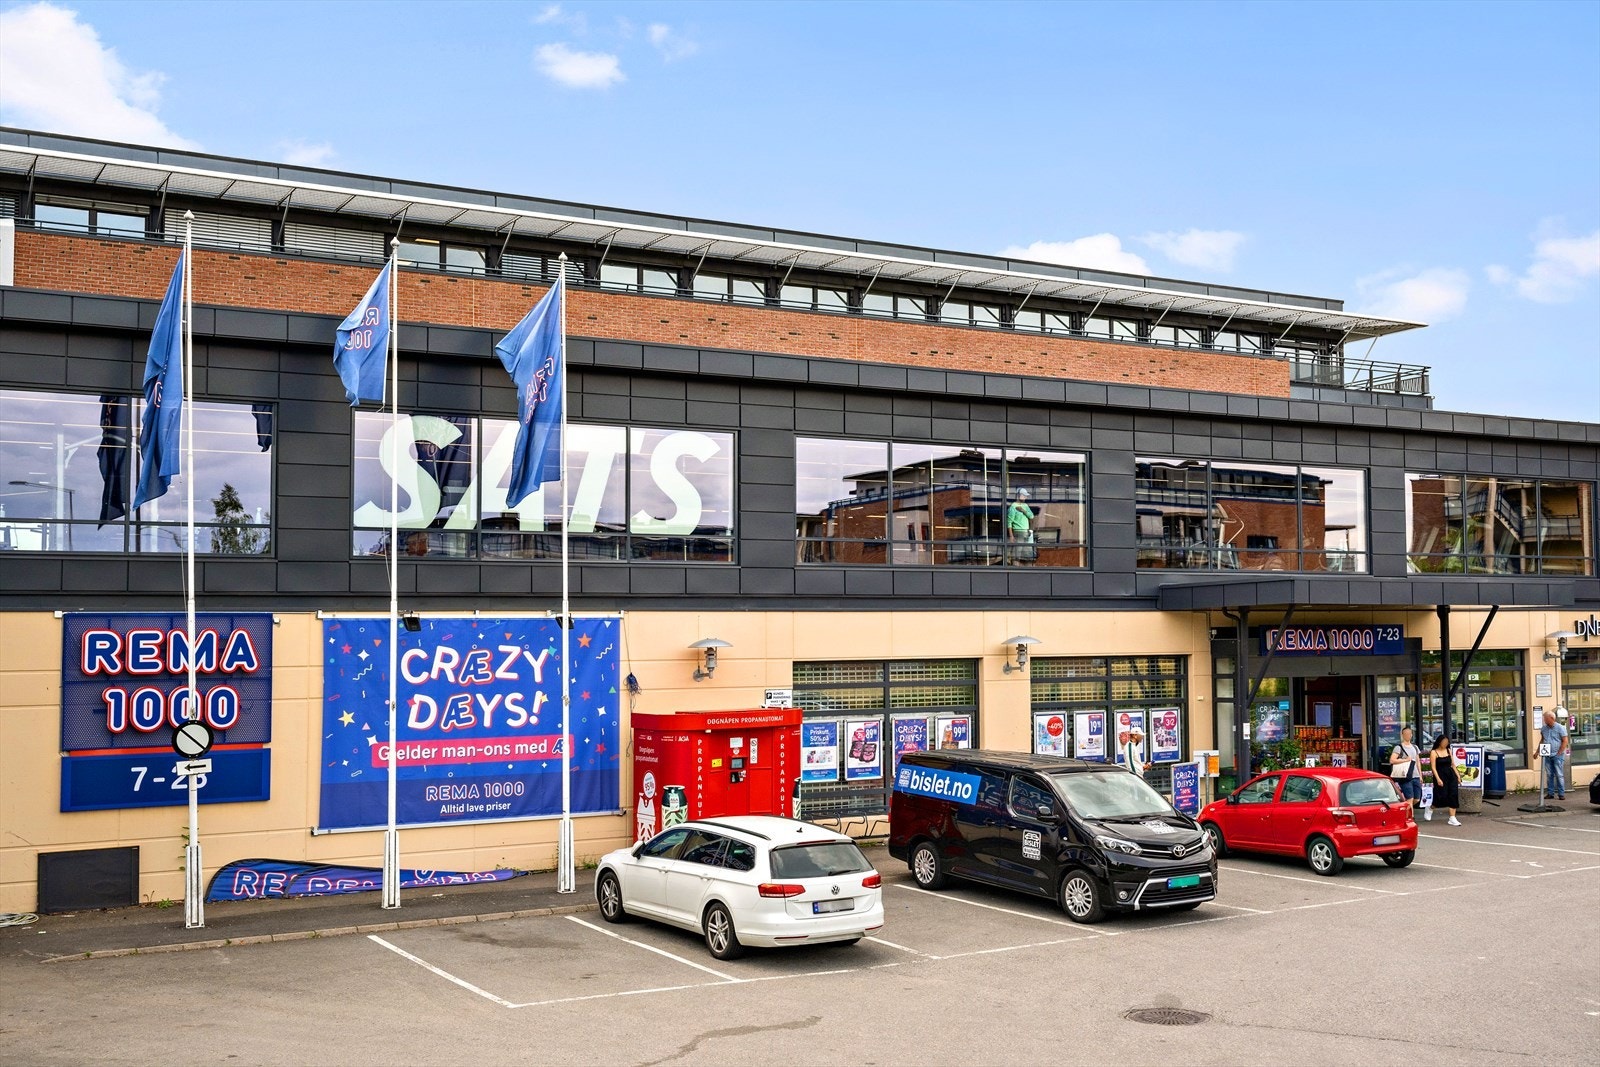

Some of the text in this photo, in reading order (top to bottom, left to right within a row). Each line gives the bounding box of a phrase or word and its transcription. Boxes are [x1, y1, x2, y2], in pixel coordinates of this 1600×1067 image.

[354, 413, 721, 536] SATS
[1329, 629, 1374, 650] 1000
[1377, 628, 1400, 641] 7-23
[81, 627, 260, 676] REMA
[400, 645, 550, 686] CRÆZY
[102, 684, 240, 734] 1000
[407, 690, 545, 732] DÆYS!
[741, 715, 784, 723] PROPANAUTOMAT
[442, 743, 511, 760] man-ons
[515, 740, 548, 755] med
[1466, 754, 1474, 765] 19
[426, 781, 525, 801] REMA 1000
[910, 770, 972, 799] bislet.no
[440, 801, 511, 814] Alltid lave priser
